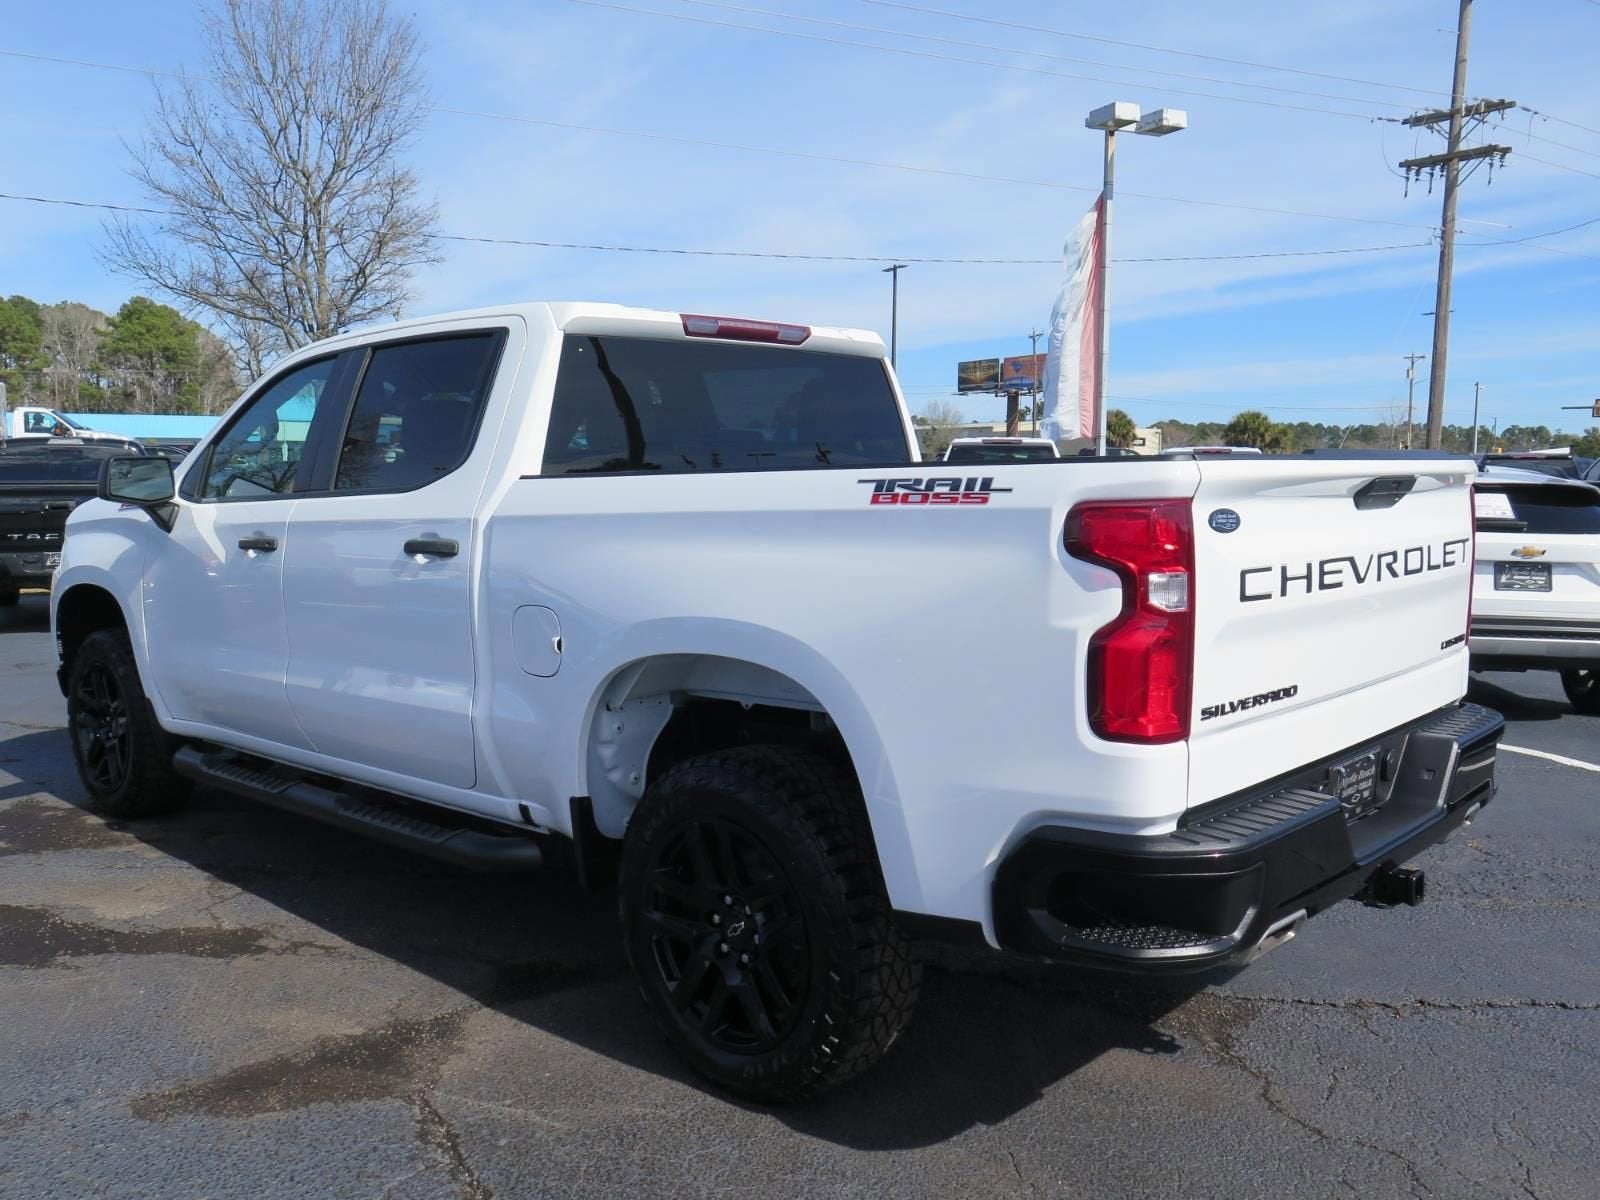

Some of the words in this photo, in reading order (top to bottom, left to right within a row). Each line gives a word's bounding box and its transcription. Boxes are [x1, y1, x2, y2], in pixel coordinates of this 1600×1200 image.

[857, 477, 1013, 493] TRAIL
[870, 492, 991, 505] BOSS
[1240, 538, 1470, 602] CHEVROLET
[1200, 685, 1298, 721] SILVERADO
